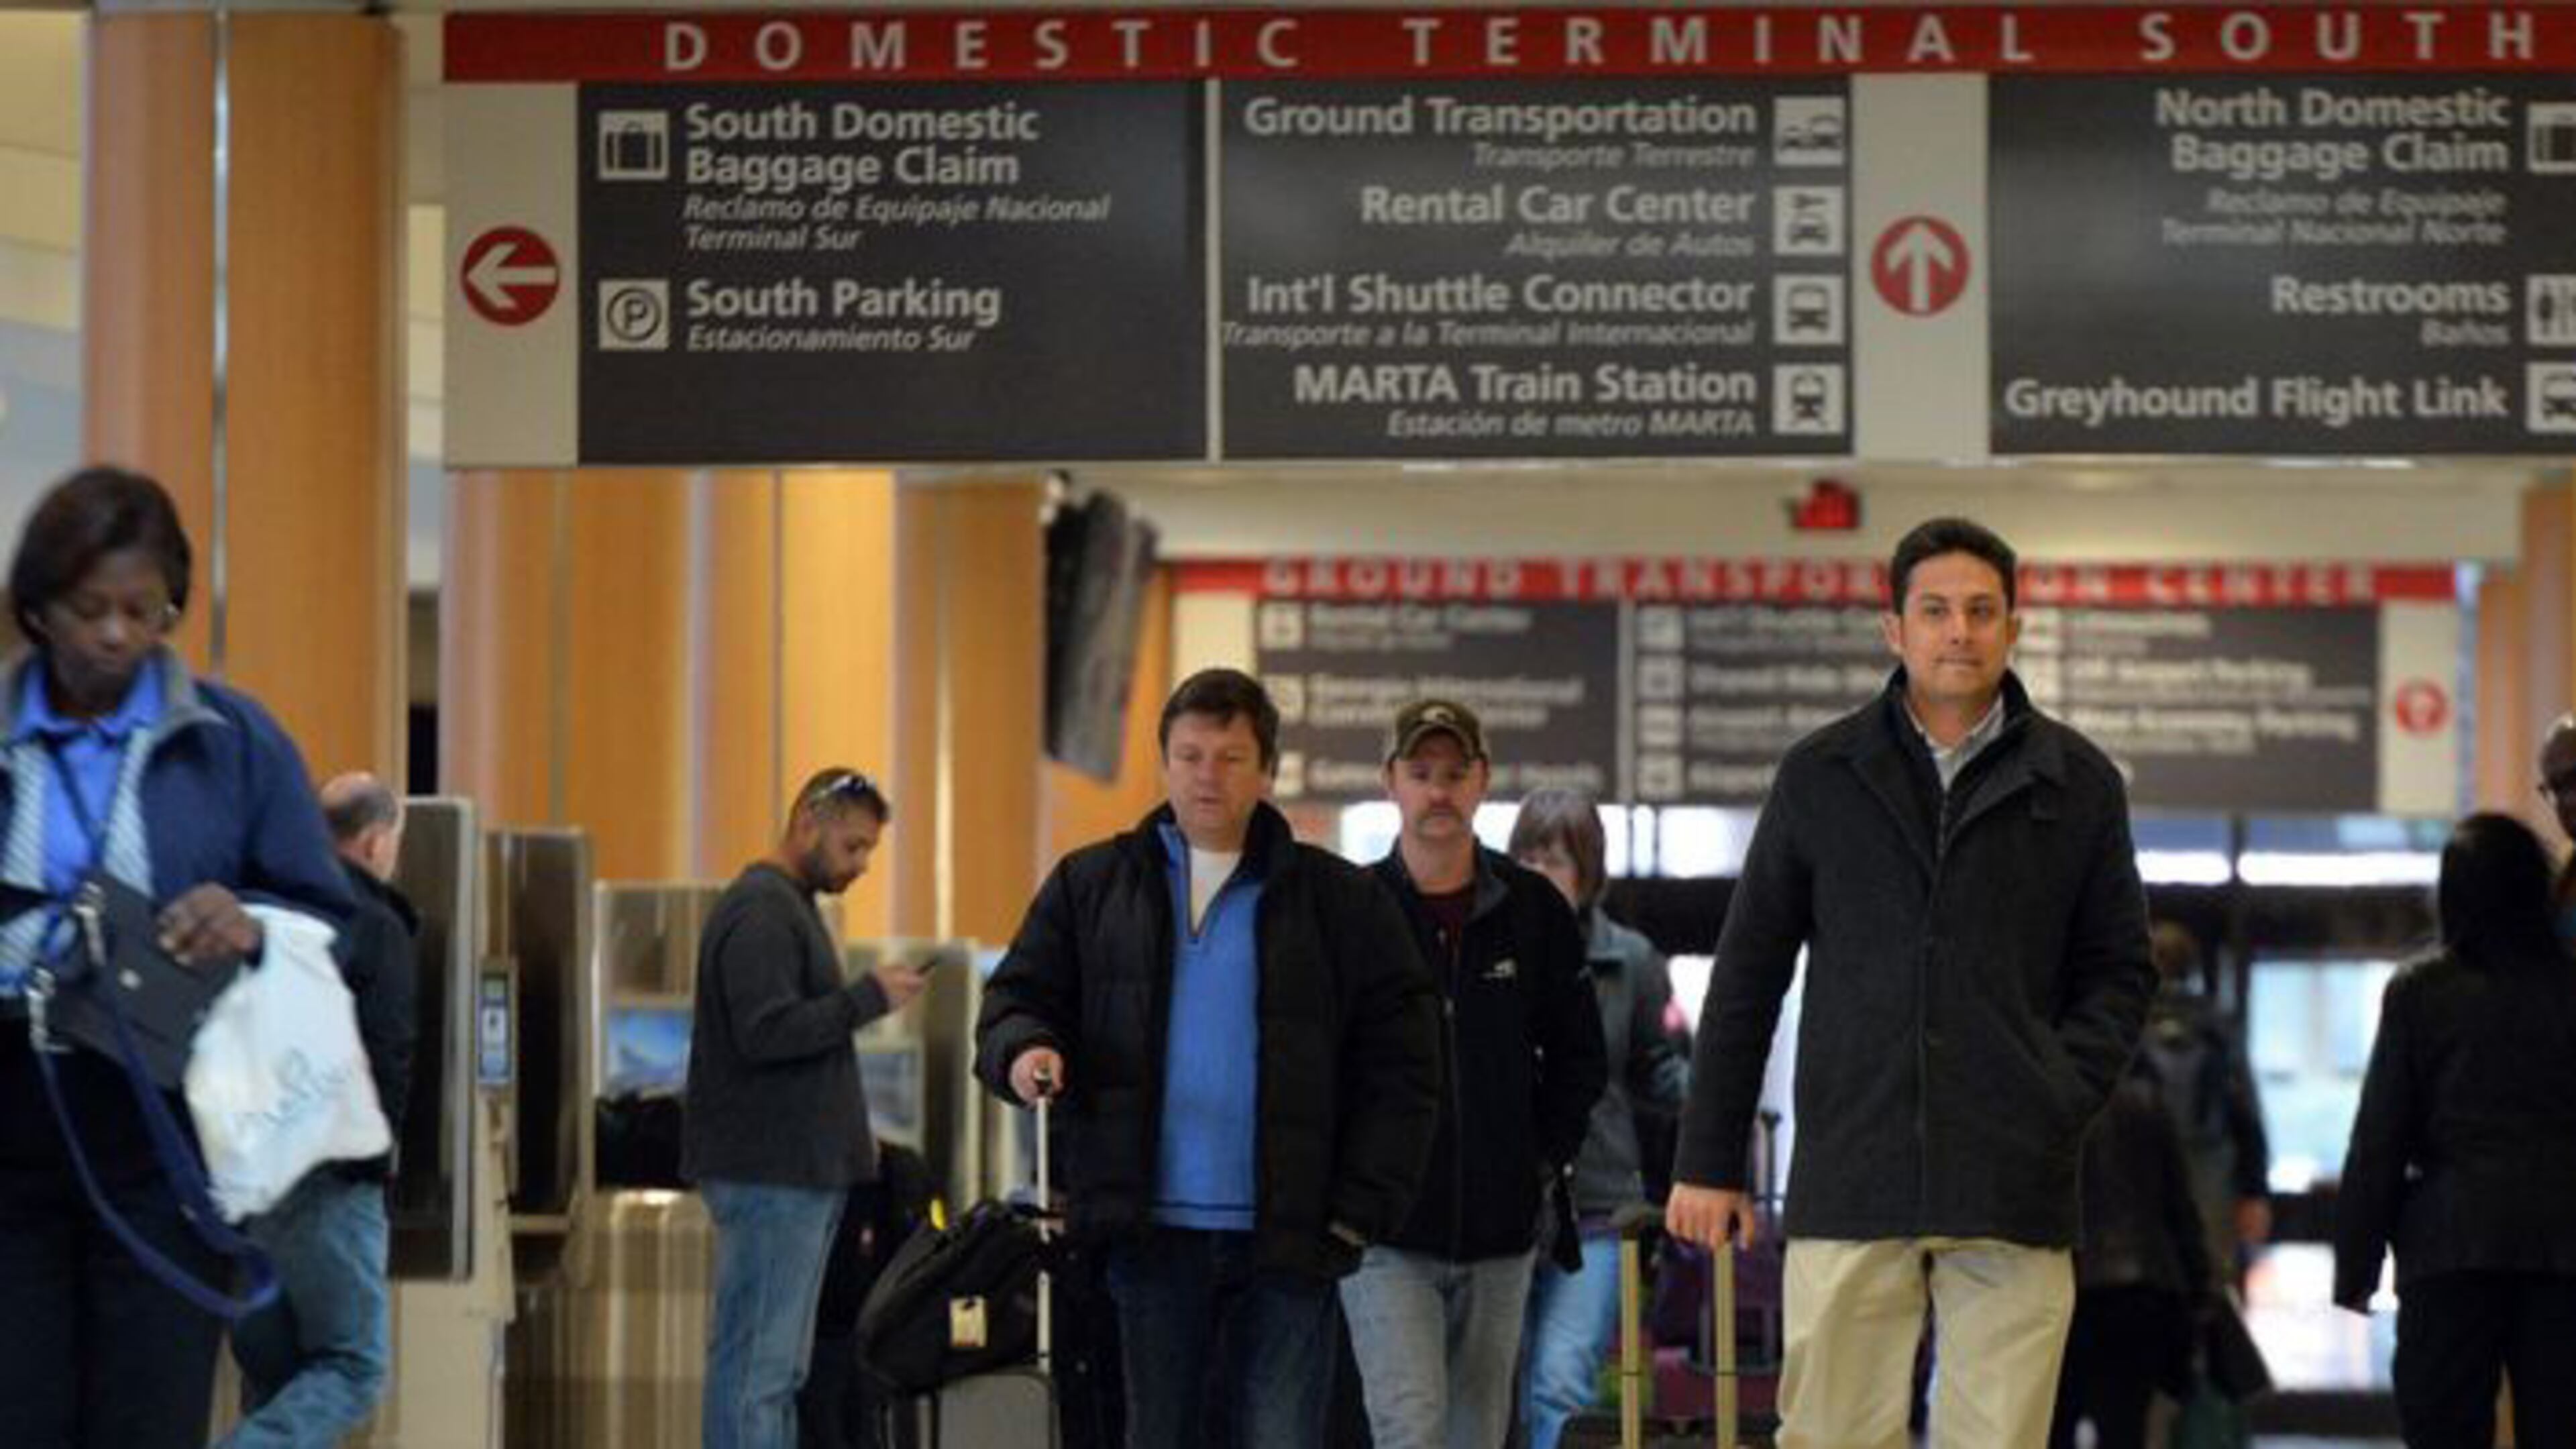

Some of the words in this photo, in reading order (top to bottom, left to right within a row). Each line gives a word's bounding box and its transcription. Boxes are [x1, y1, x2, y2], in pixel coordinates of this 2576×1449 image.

[665, 19, 1300, 70] DOMESTIC
[1402, 15, 2033, 66] TERMINAL
[2140, 11, 2534, 62] SOUTH
[686, 101, 817, 142] South
[833, 101, 1039, 141] Domestic
[1244, 96, 1413, 135] Ground
[1424, 96, 1757, 142] Transportation
[2155, 89, 2287, 126] North
[2300, 88, 2509, 126] Domestic
[686, 147, 881, 194] Baggage
[894, 146, 1020, 184] Claim
[1474, 143, 1623, 172] Transporte
[1632, 143, 1756, 168] Terrestre
[2171, 136, 2369, 180] Baggage
[2381, 134, 2508, 172] Claim
[683, 197, 805, 221] Reclamo
[812, 196, 848, 221] de
[855, 197, 979, 229] Equipaje
[984, 195, 1112, 221] Nacional
[1361, 184, 1504, 224] Rental
[1517, 185, 1594, 223] Car
[1605, 185, 1755, 223] Center
[2204, 189, 2330, 215] Reclamo
[2334, 189, 2372, 214] de
[2378, 189, 2507, 221] Equipaje
[686, 225, 808, 252] Terminal
[814, 227, 861, 252] Sur
[1505, 232, 1619, 262] Alquiler
[1626, 232, 1663, 258] de
[1669, 232, 1755, 258] Autos
[2161, 219, 2284, 245] Terminal
[2290, 219, 2414, 245] Nacional
[2422, 219, 2506, 244] Norte
[687, 278, 818, 317] South
[833, 277, 1001, 326] Parking
[1248, 273, 1334, 313] Int'l
[1348, 273, 1509, 313] Shuttle
[1523, 275, 1754, 313] Connector
[2270, 276, 2510, 314] Restrooms
[686, 325, 922, 352] Estacionamiento
[928, 325, 977, 350] Sur
[1222, 322, 1366, 351] Transporte
[1375, 327, 1395, 345] a
[1402, 321, 1429, 346] la
[1437, 321, 1560, 346] Terminal
[1566, 321, 1756, 346] Internacional
[1294, 364, 1459, 402] MARTA
[1470, 364, 1581, 402] Train
[1595, 363, 1756, 402] Station
[2004, 377, 2259, 426] Greyhound
[2272, 376, 2401, 425] Flight
[2414, 376, 2508, 416] Link
[1510, 410, 1548, 436] de
[1555, 413, 1642, 437] metro
[1648, 411, 1755, 435] MARTA
